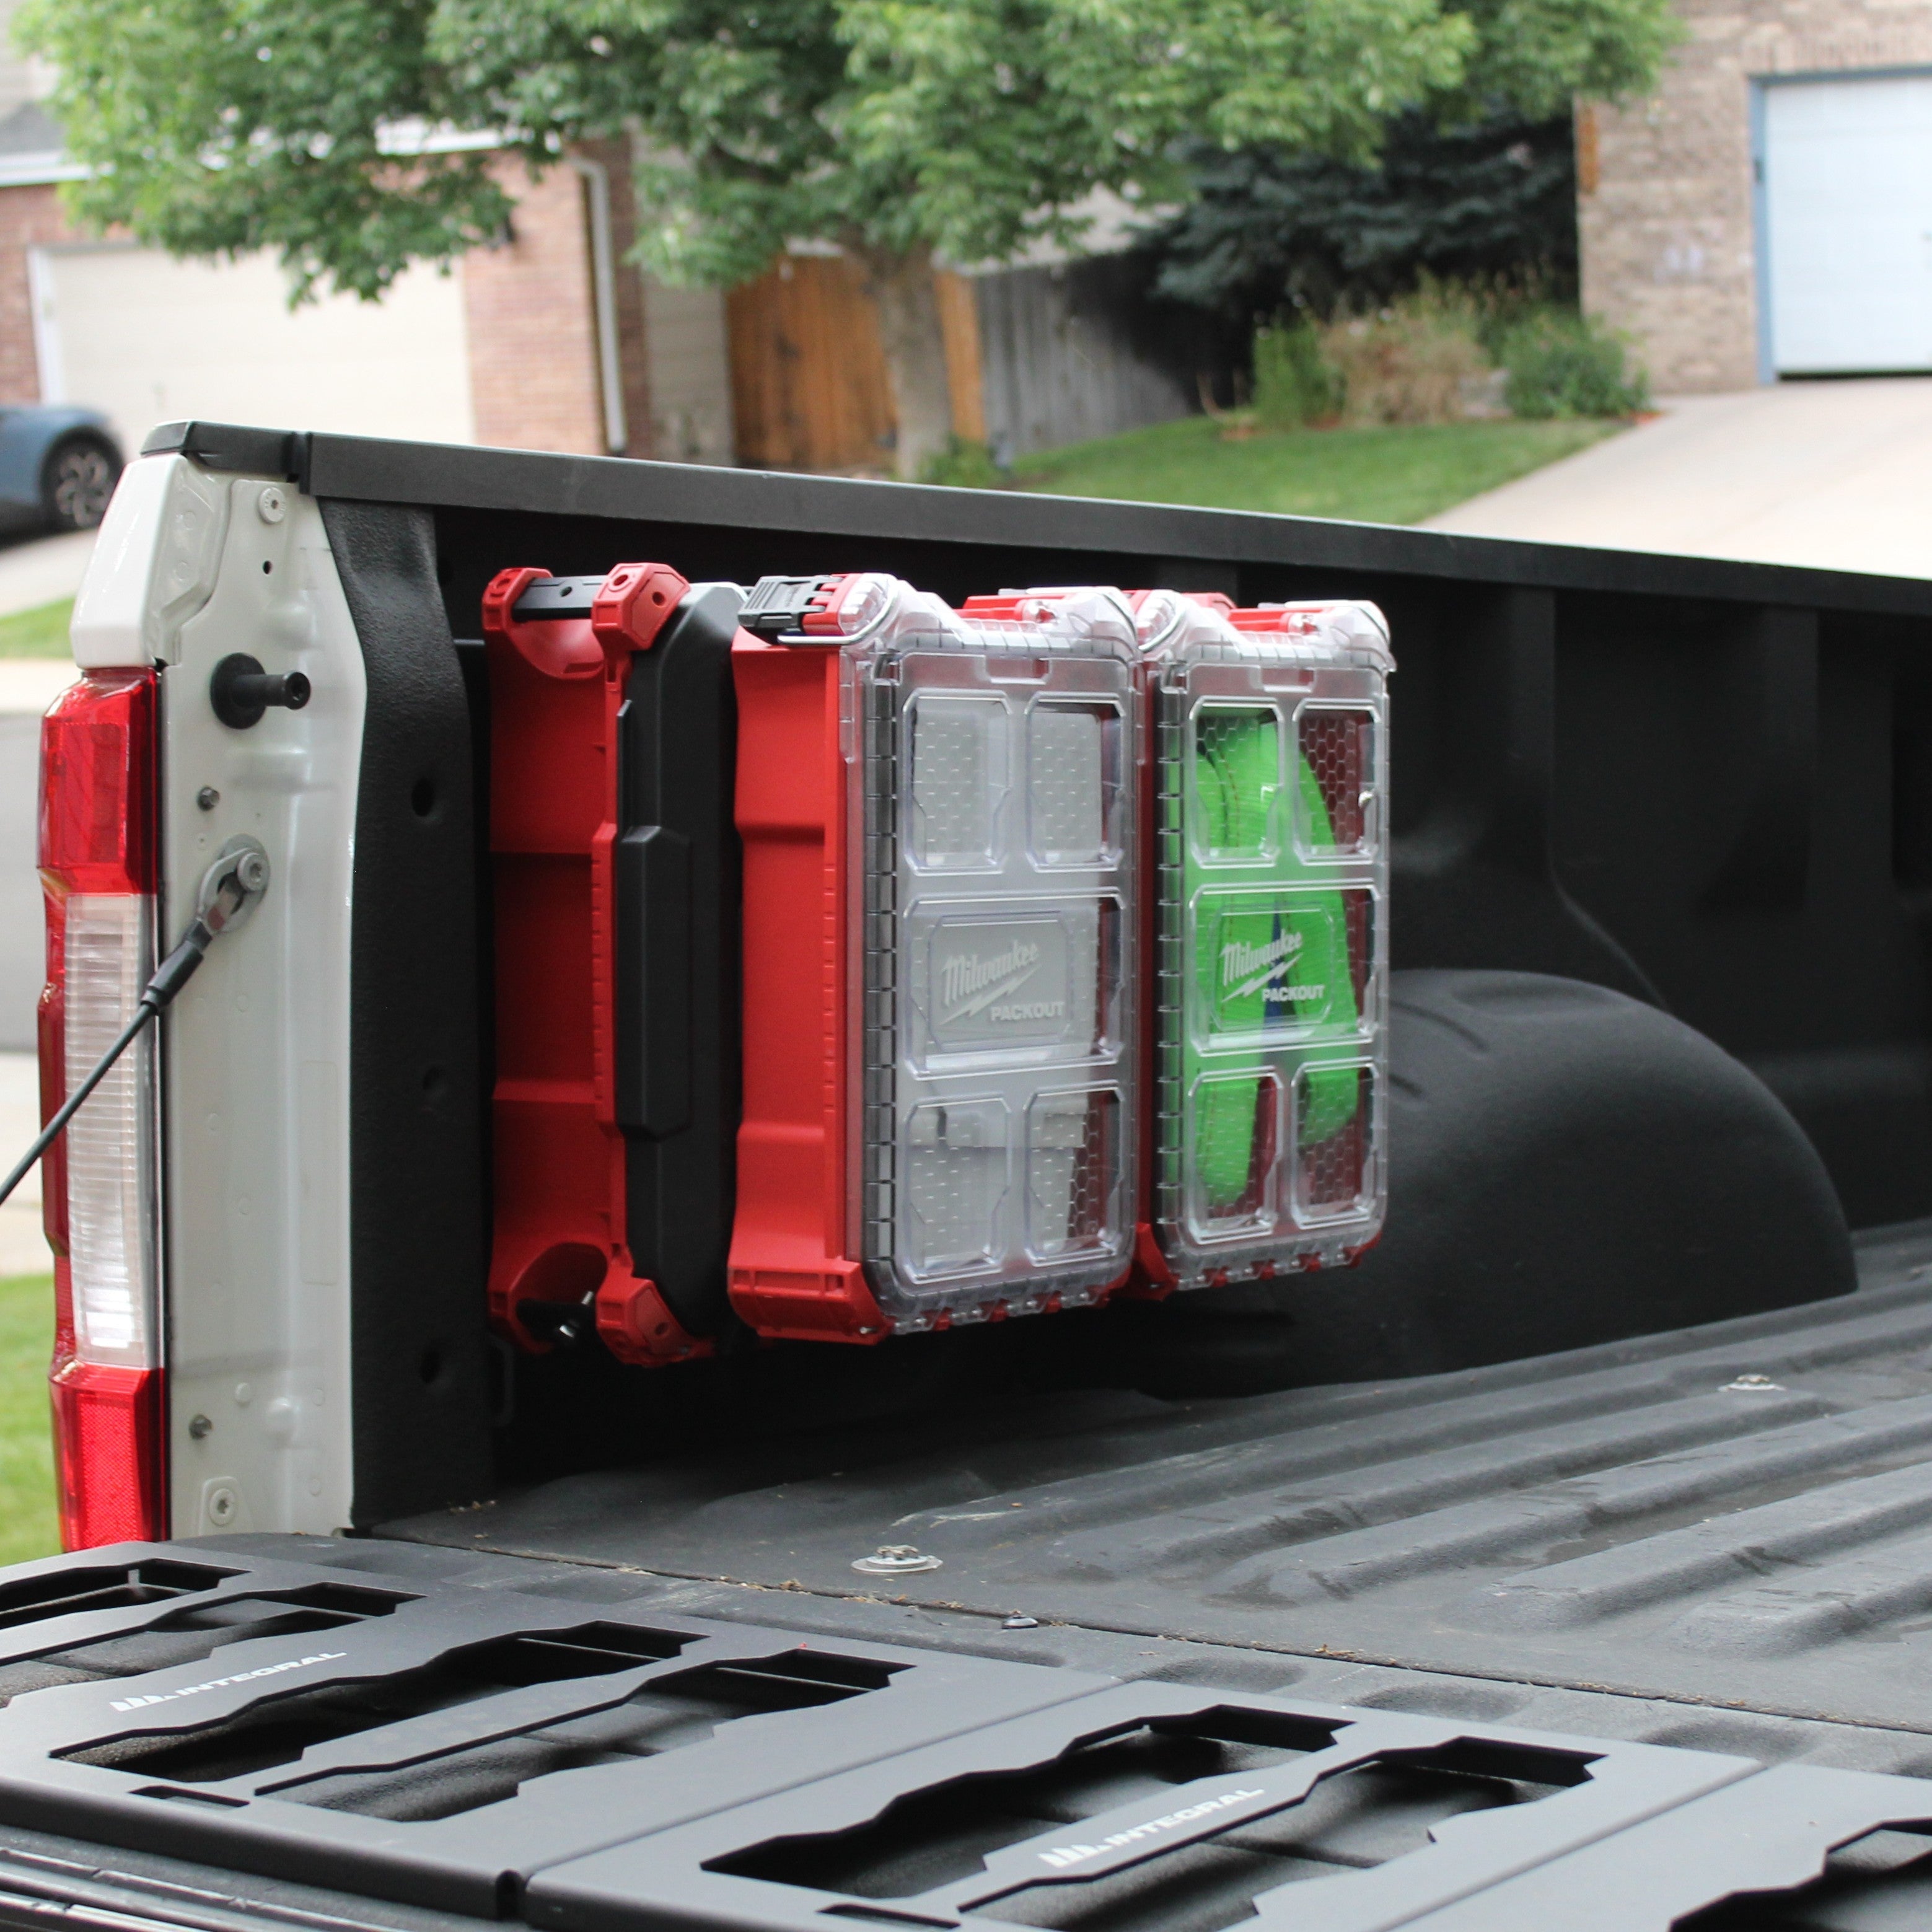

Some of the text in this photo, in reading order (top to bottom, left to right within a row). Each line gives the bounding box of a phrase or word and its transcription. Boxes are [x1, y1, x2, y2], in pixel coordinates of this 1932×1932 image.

[941, 939, 1038, 1008] Milwaukee
[1219, 929, 1302, 986] Milwaukee
[991, 1001, 1065, 1021] PACKOUT
[1262, 985, 1324, 1002] PACKOUT
[175, 1652, 347, 1695] INTEGRAL
[1105, 1789, 1265, 1846] INTEGRAL
